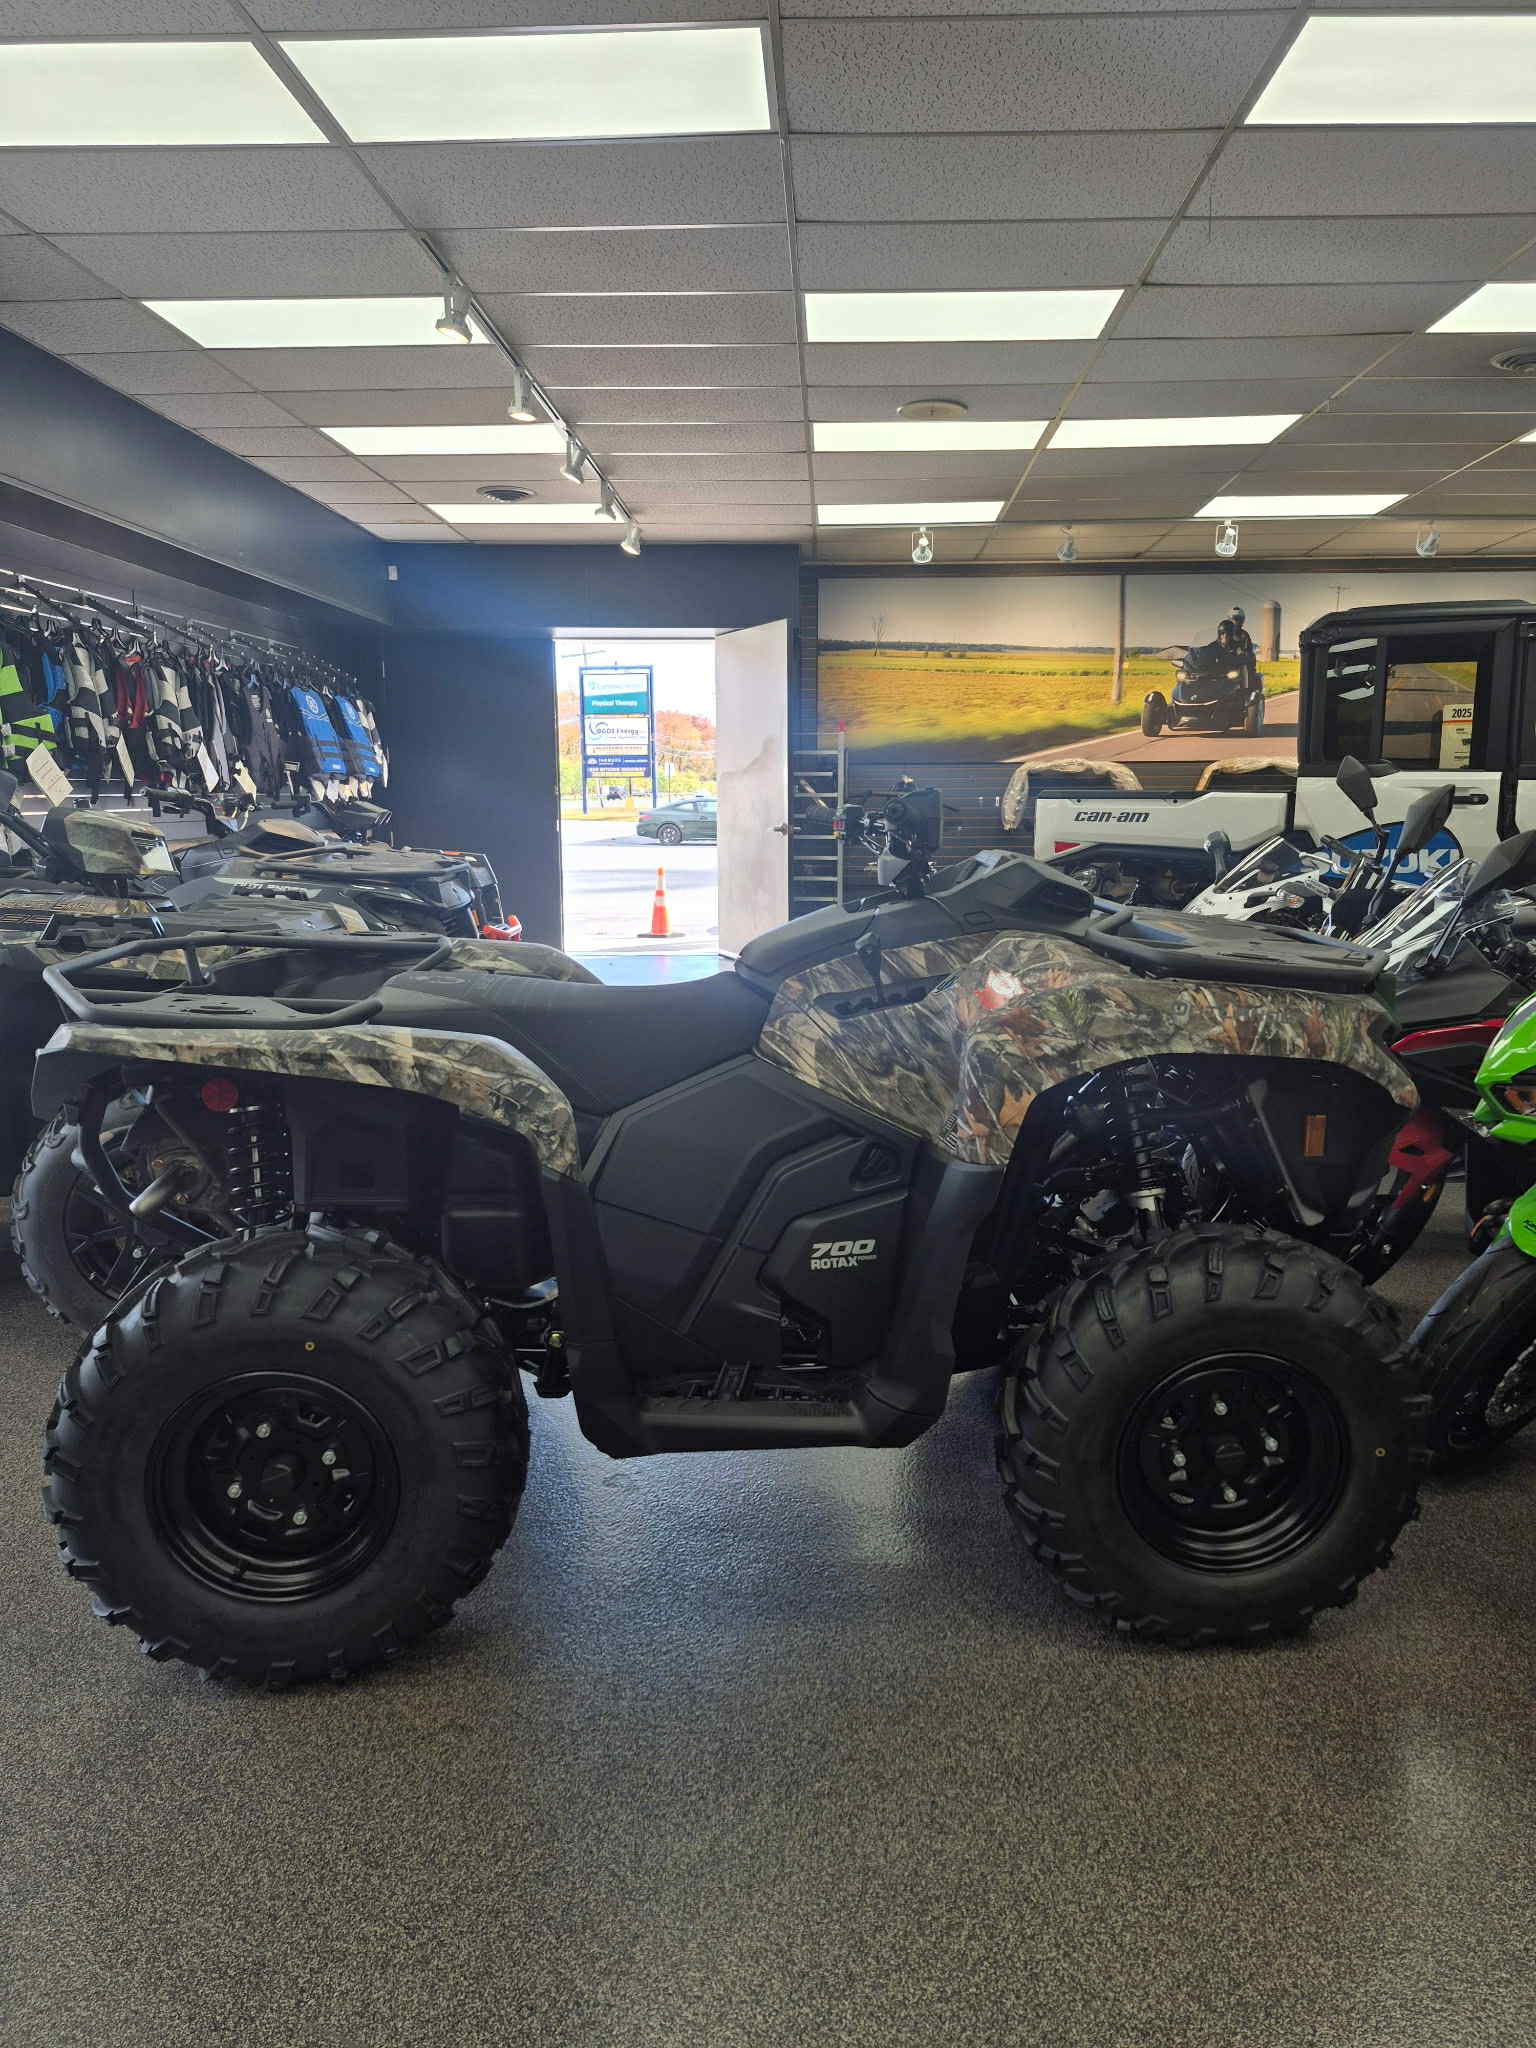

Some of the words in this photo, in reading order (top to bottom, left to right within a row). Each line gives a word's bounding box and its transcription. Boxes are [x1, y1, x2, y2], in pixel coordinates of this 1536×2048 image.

[1451, 708, 1472, 718] 2025
[1074, 811, 1150, 823] can-am
[811, 1239, 876, 1258] 700
[811, 1257, 858, 1270] ROTAX
